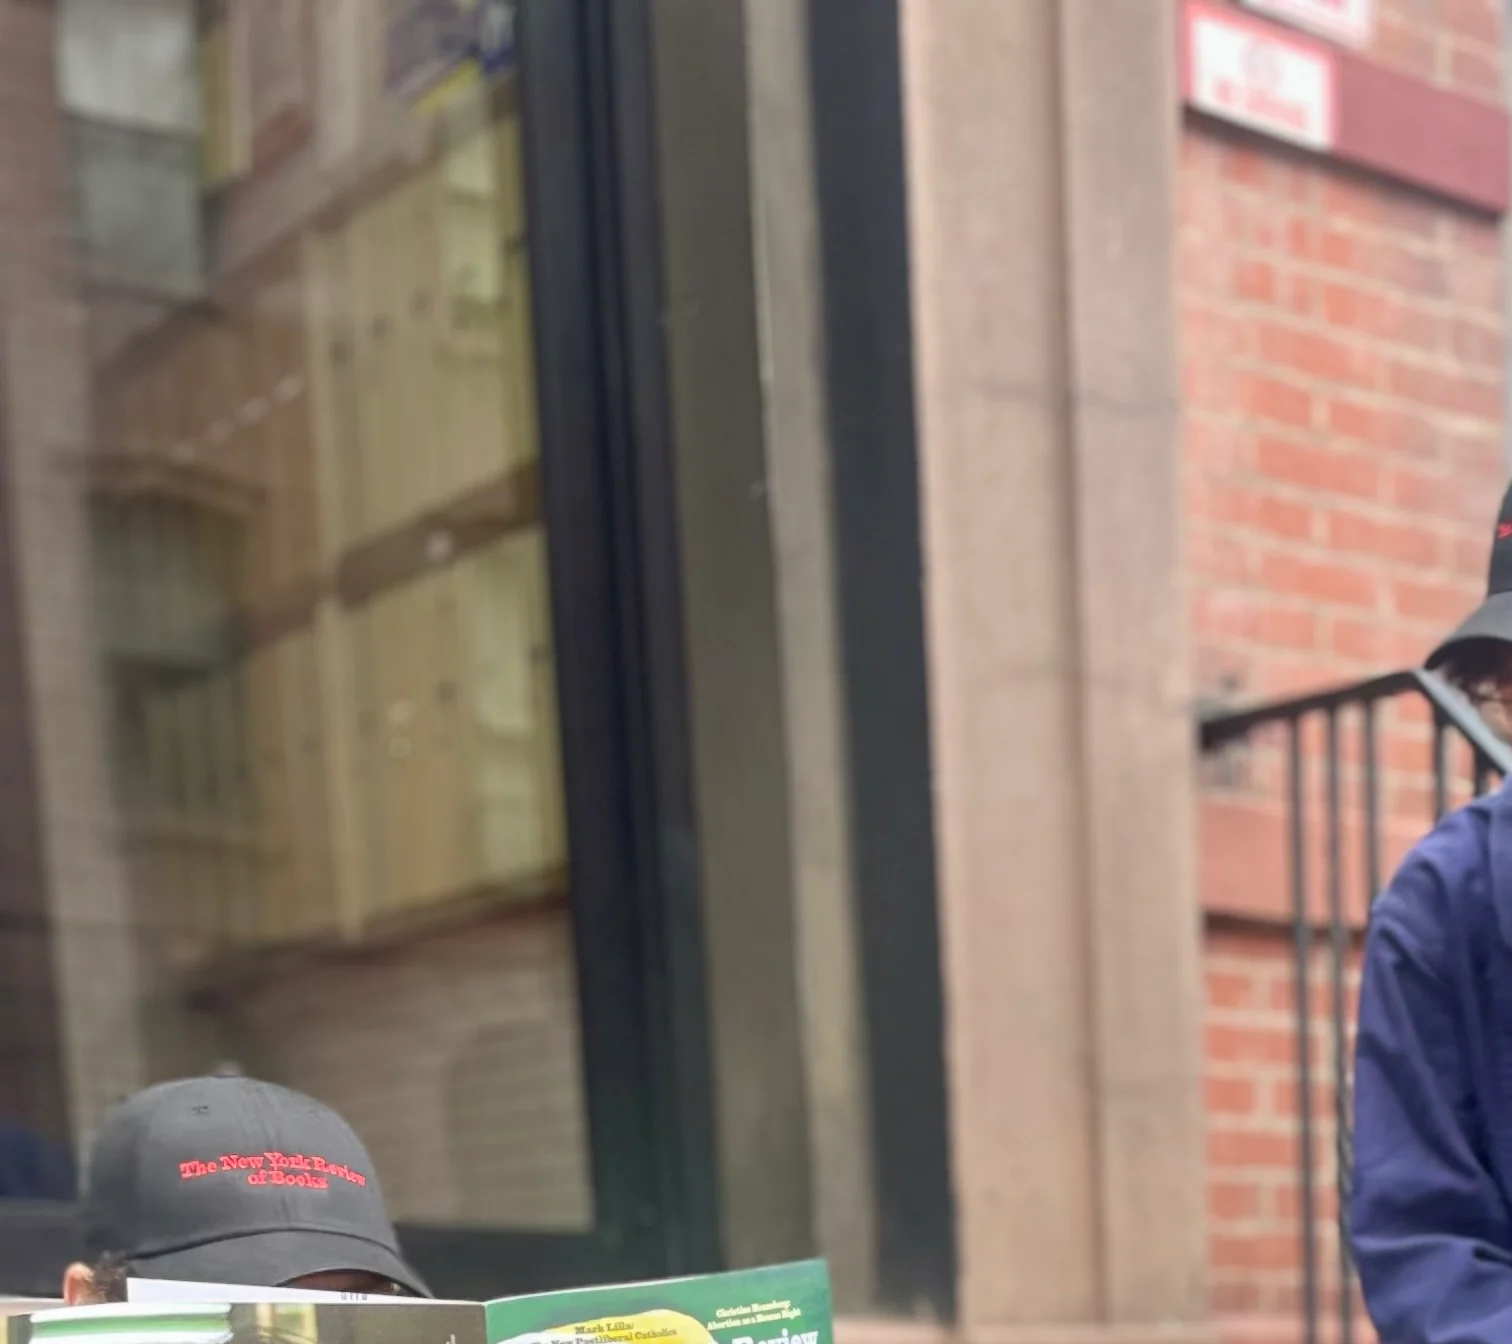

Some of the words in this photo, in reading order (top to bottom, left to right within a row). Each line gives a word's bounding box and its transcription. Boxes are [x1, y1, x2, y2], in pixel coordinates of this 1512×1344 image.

[180, 1161, 217, 1178] The
[220, 1155, 264, 1171] New
[263, 1152, 312, 1171] York
[311, 1156, 366, 1186] Review
[247, 1169, 270, 1185] of
[268, 1170, 329, 1189] Books
[707, 1316, 741, 1330] Abortion
[756, 1311, 782, 1324] Human
[781, 1308, 801, 1322] Right
[716, 1304, 750, 1319] Christine
[574, 1323, 604, 1336] Mark
[606, 1318, 634, 1331] Lilla:
[634, 1325, 677, 1341] Catholics
